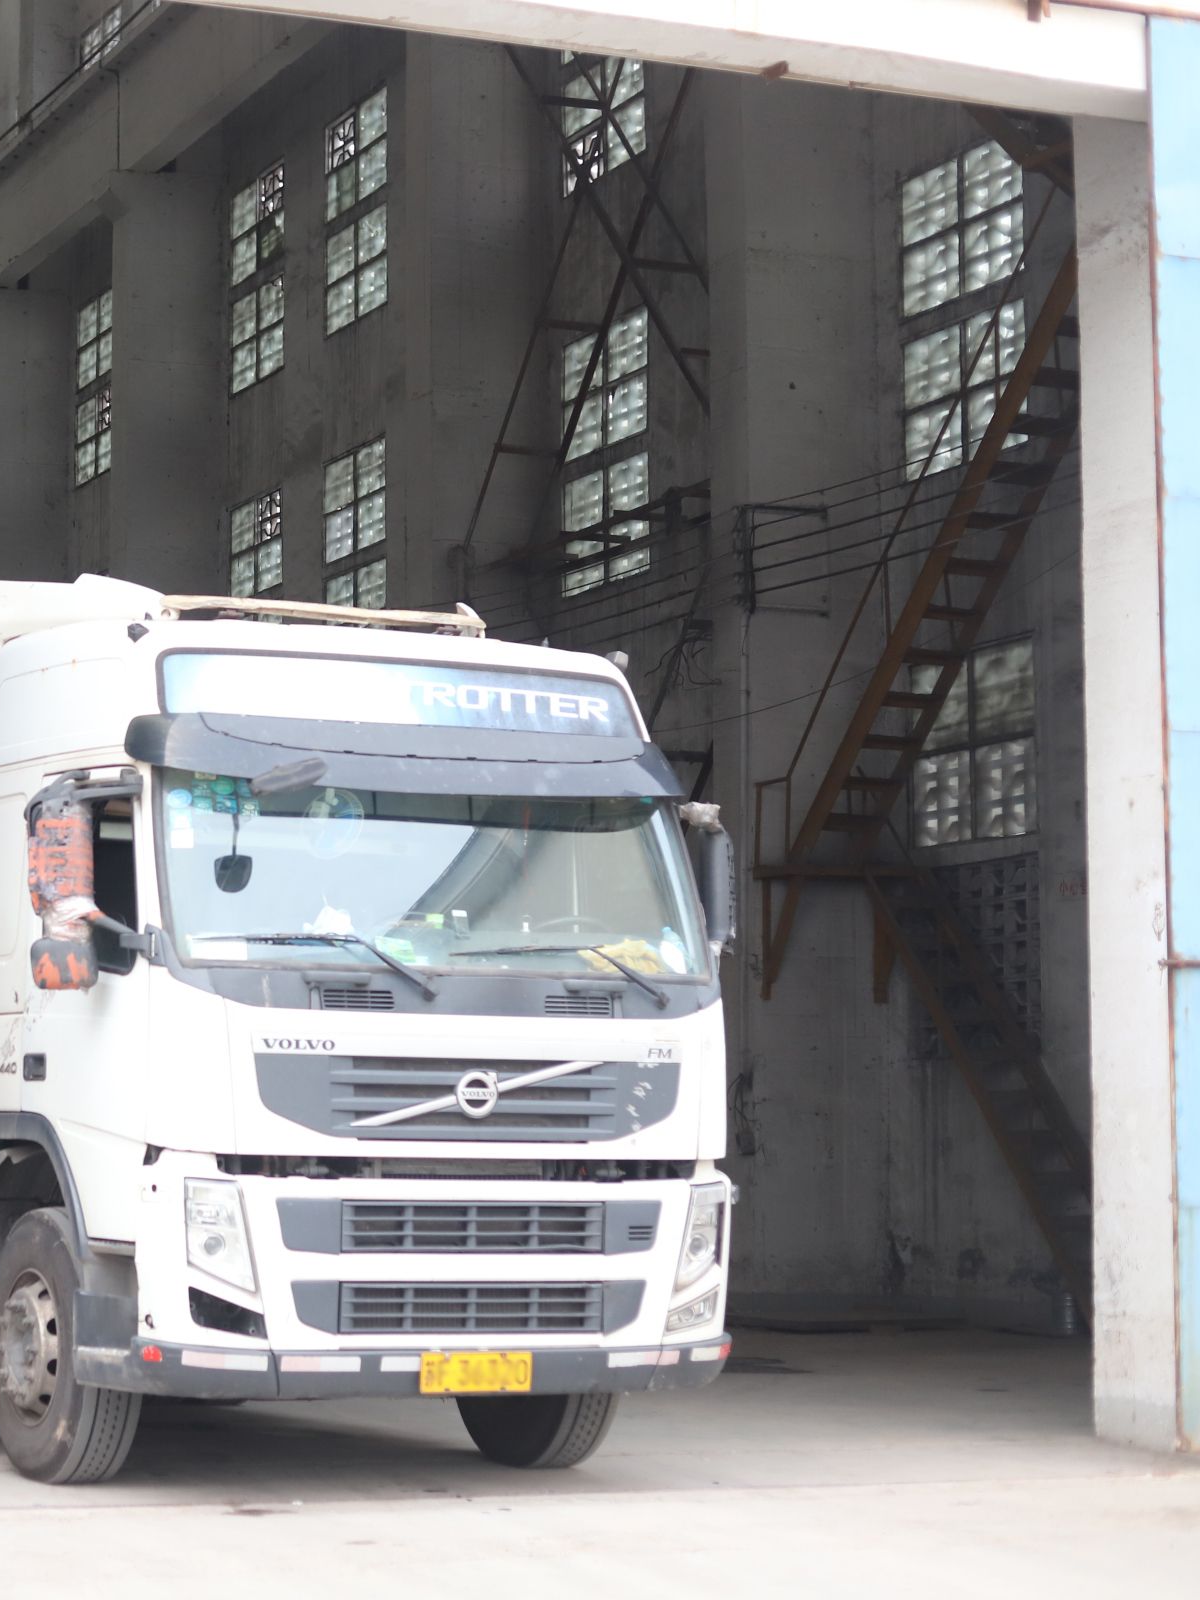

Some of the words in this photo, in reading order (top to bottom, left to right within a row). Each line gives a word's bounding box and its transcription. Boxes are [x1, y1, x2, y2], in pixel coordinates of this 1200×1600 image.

[261, 1038, 336, 1051] VOLVO
[647, 1047, 672, 1059] FM
[461, 1090, 496, 1098] VOLVO
